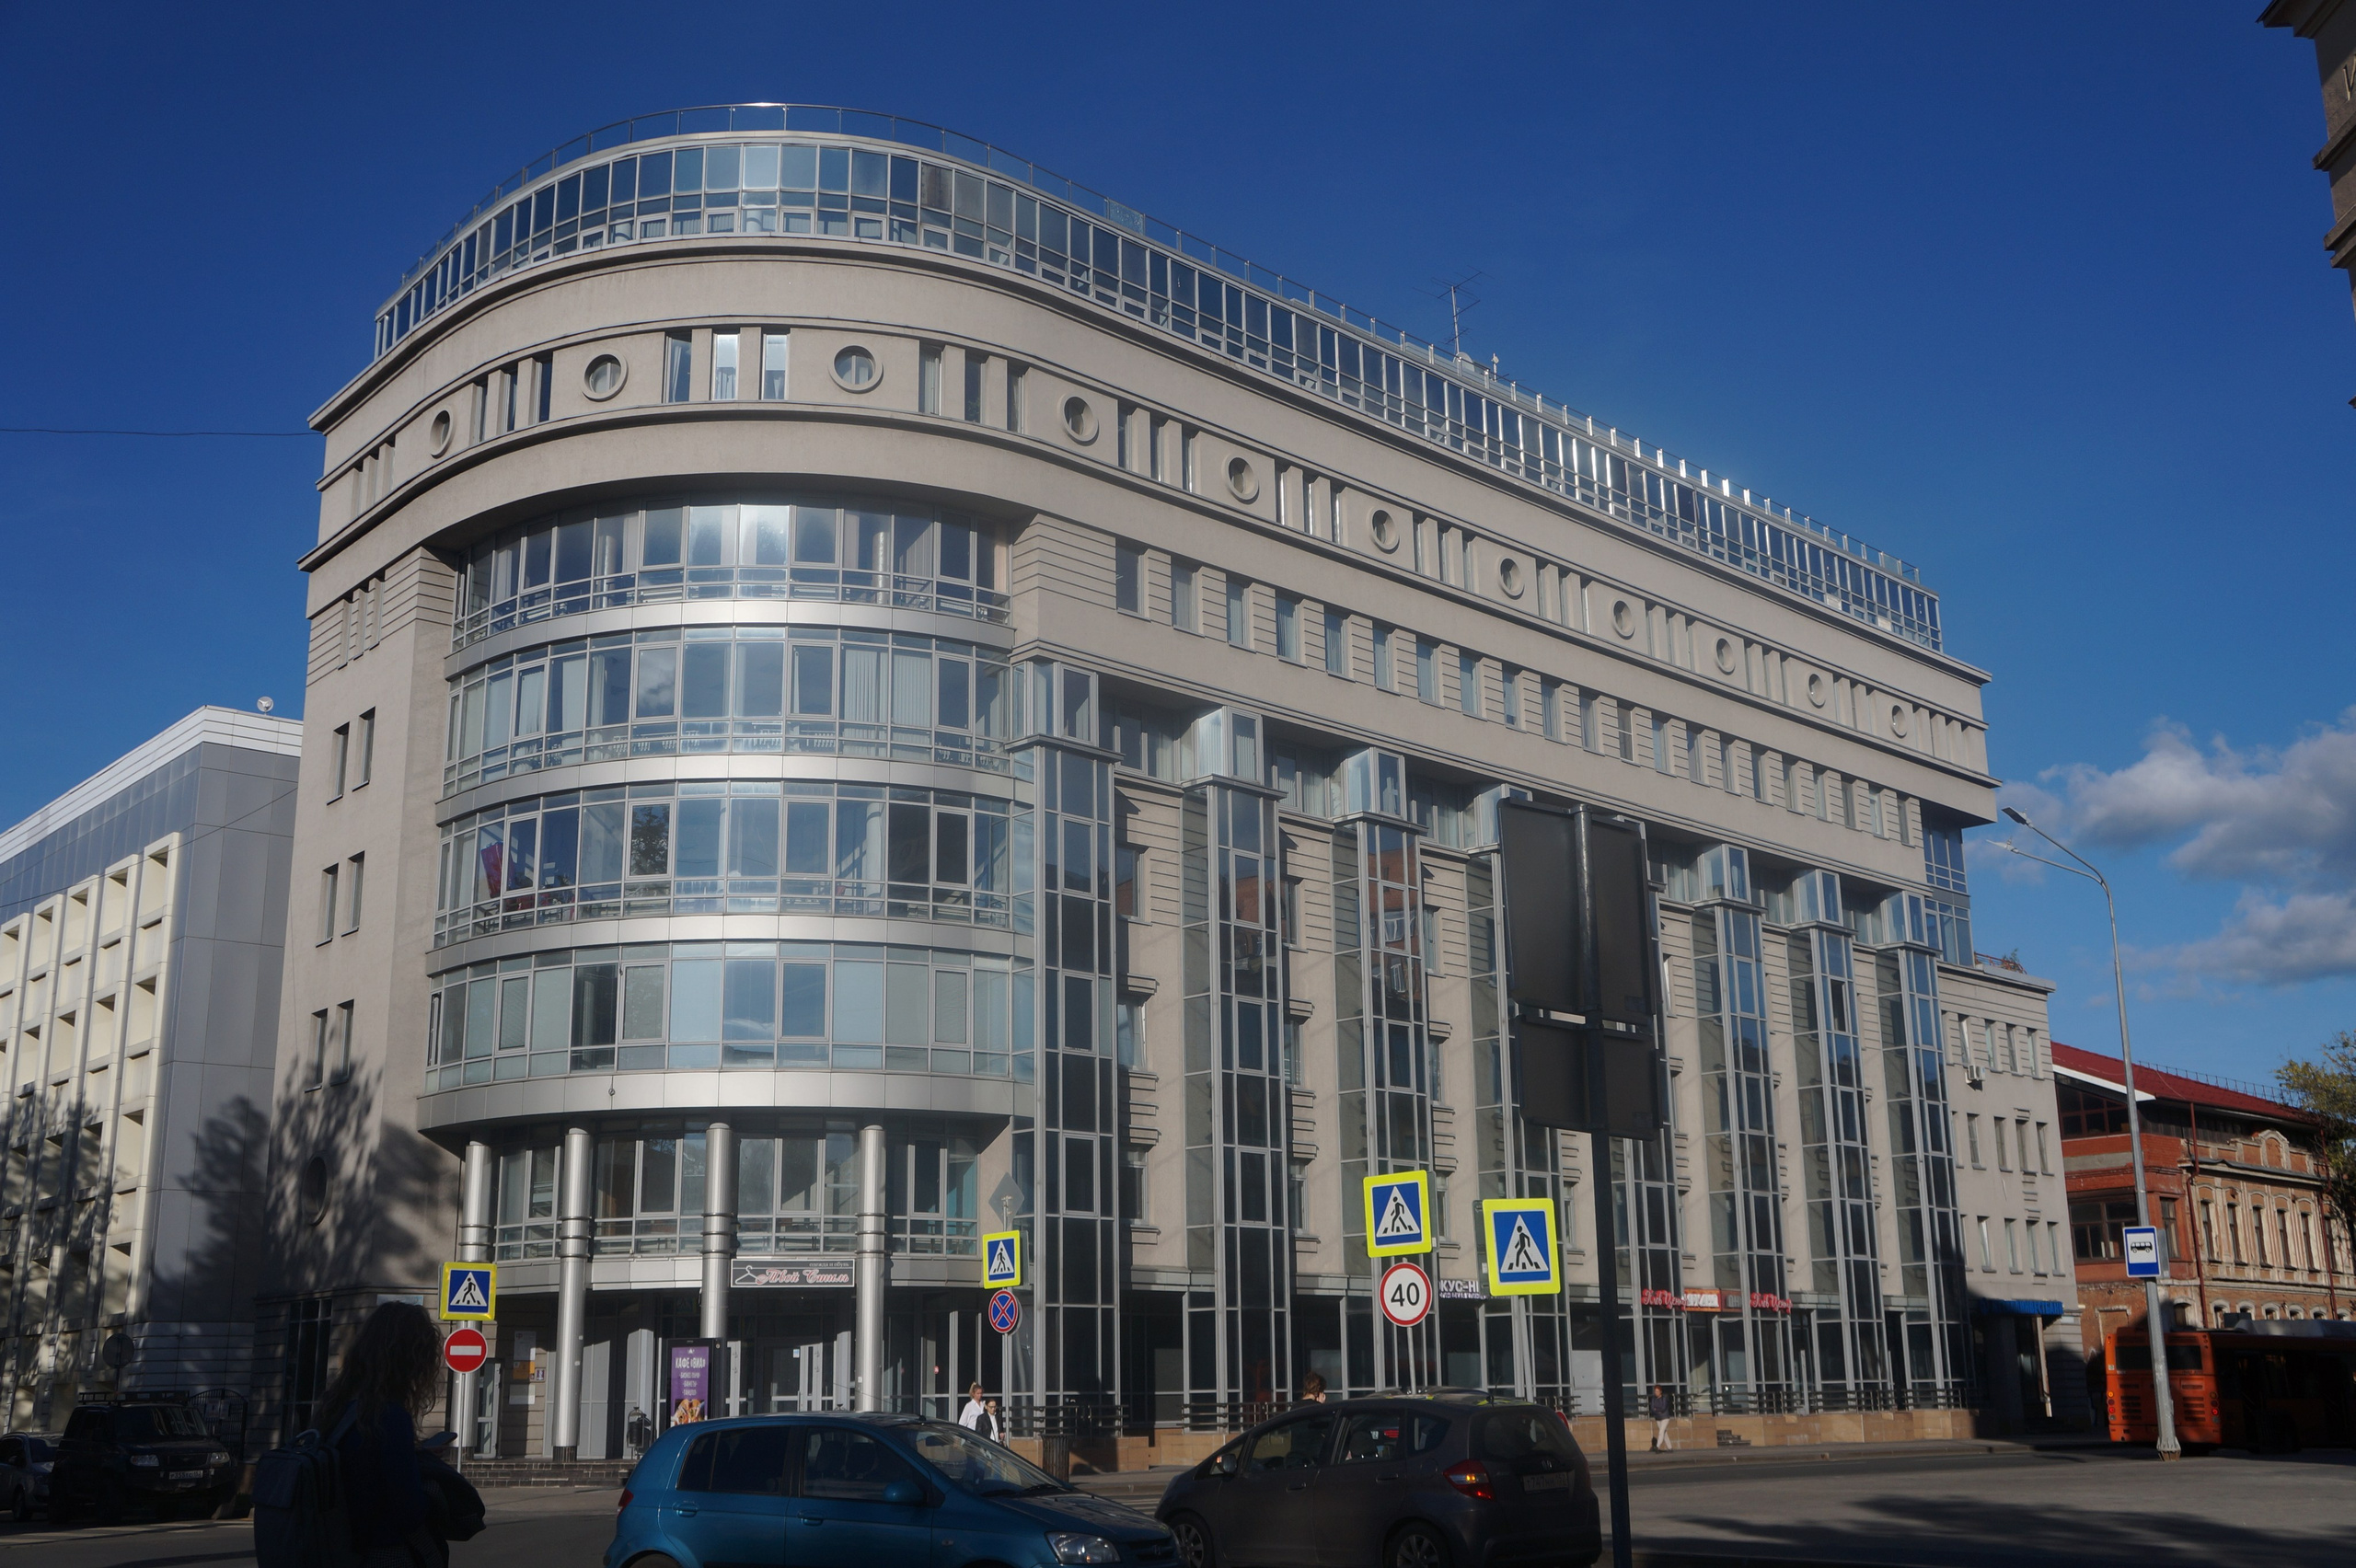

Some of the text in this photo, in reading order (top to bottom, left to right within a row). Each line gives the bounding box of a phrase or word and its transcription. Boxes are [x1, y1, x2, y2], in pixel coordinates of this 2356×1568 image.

[756, 1268, 849, 1286] Твой Стиль
[1439, 1280, 1479, 1293] КУС-Н
[1391, 1282, 1420, 1307] 40
[675, 1357, 690, 1368] КАФЕ
